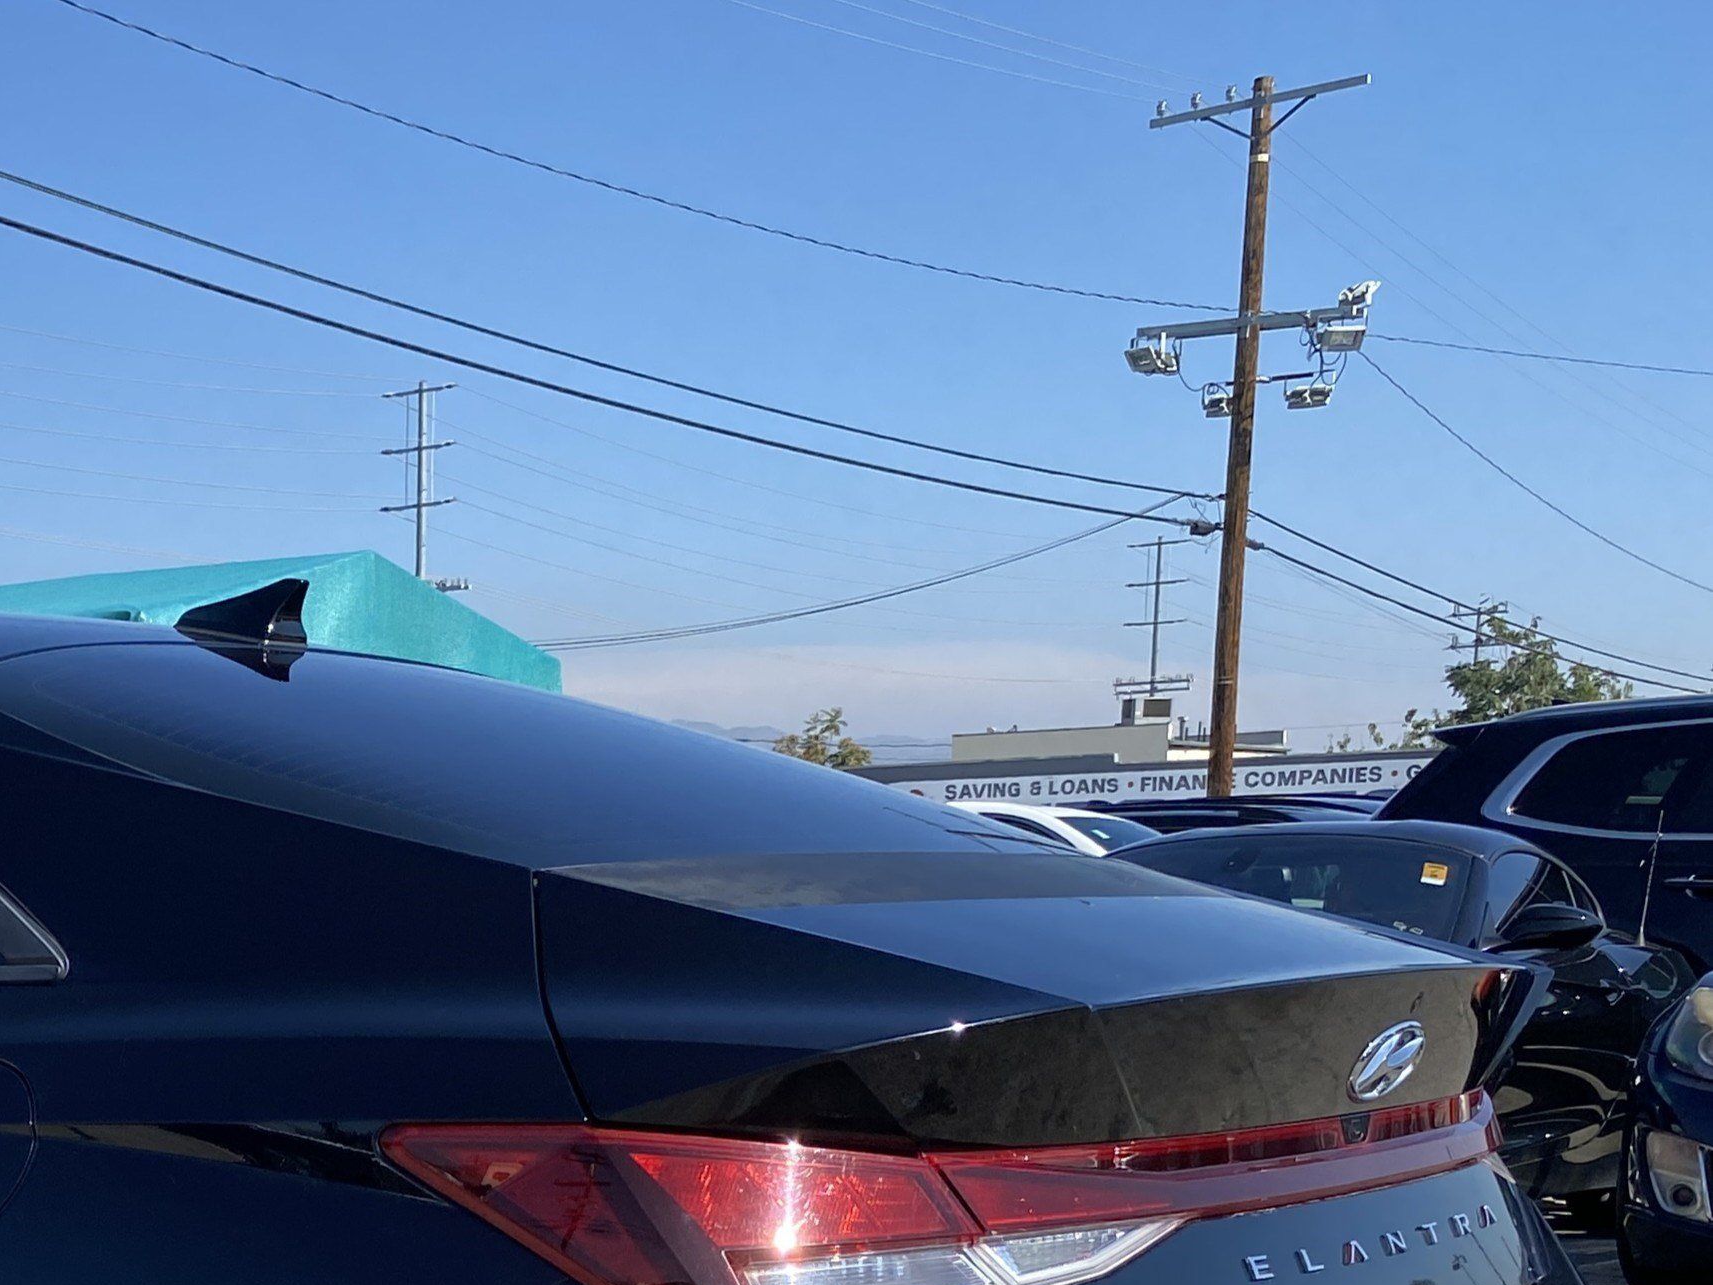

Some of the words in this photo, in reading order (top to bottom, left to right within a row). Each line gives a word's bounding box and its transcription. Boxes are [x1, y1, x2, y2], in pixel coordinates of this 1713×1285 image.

[944, 781, 1021, 801] SAVING
[1030, 780, 1041, 796] &
[1048, 778, 1118, 796] LOANS
[1243, 765, 1382, 788] COMPANIES
[1243, 1204, 1498, 1282] ELANTRA
